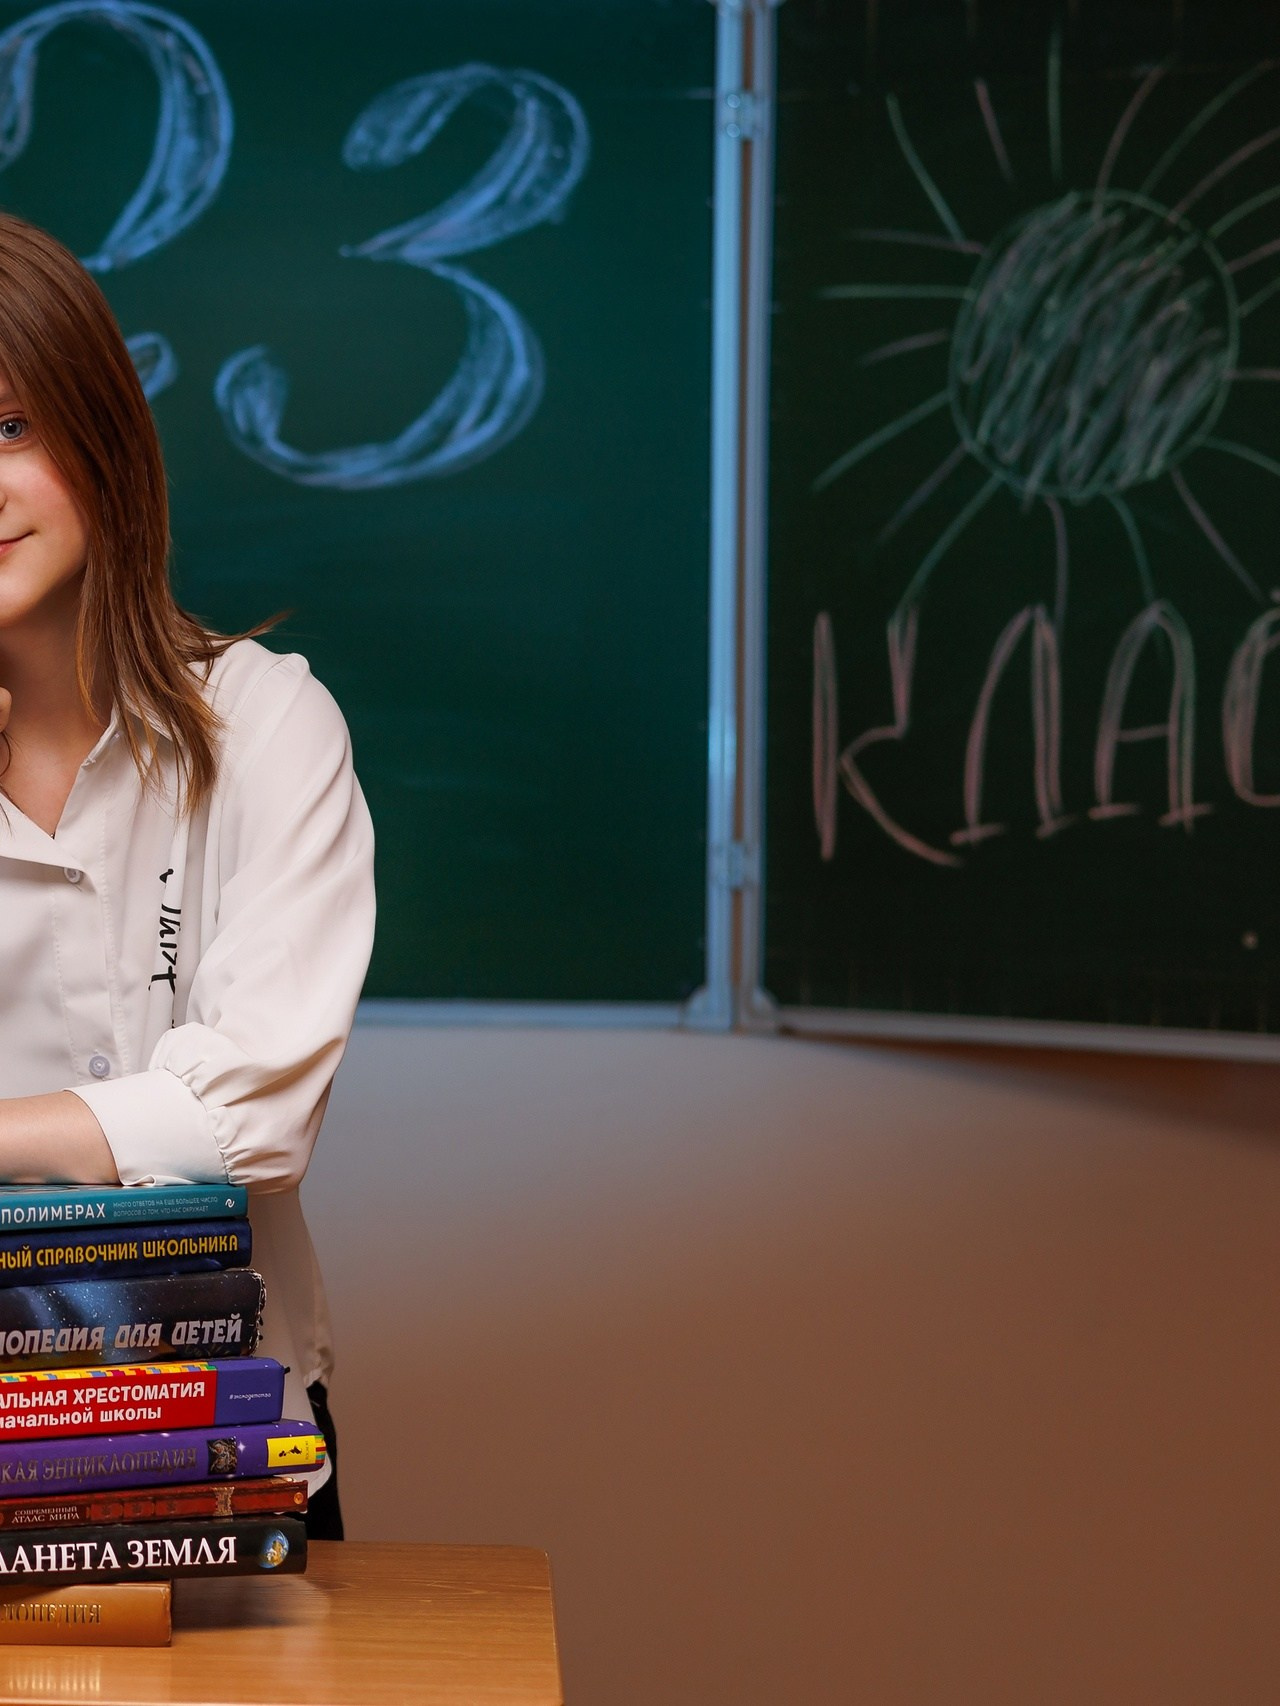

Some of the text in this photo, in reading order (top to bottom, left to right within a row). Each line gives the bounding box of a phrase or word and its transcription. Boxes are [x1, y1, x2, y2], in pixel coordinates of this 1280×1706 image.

[1, 1202, 107, 1225] ПОЛИМЕРАХ
[36, 1241, 139, 1268] СПРАВОЧНИК
[142, 1234, 239, 1259] ШКОЛЬНИКА
[115, 1322, 162, 1350] ДЛЯ
[170, 1313, 244, 1346] ДЕТЕЙ
[73, 1381, 206, 1404] ХРЕСТОМАТИЯ
[99, 1405, 163, 1422] школы
[42, 1448, 198, 1482] ЭНЦИКЛОПЕДИЯ
[11, 1512, 80, 1524] АТЛАС МИРА
[14, 1506, 77, 1516] СОВРЕМЕННЫЙ
[127, 1536, 238, 1569] ЗЕМЛЯ
